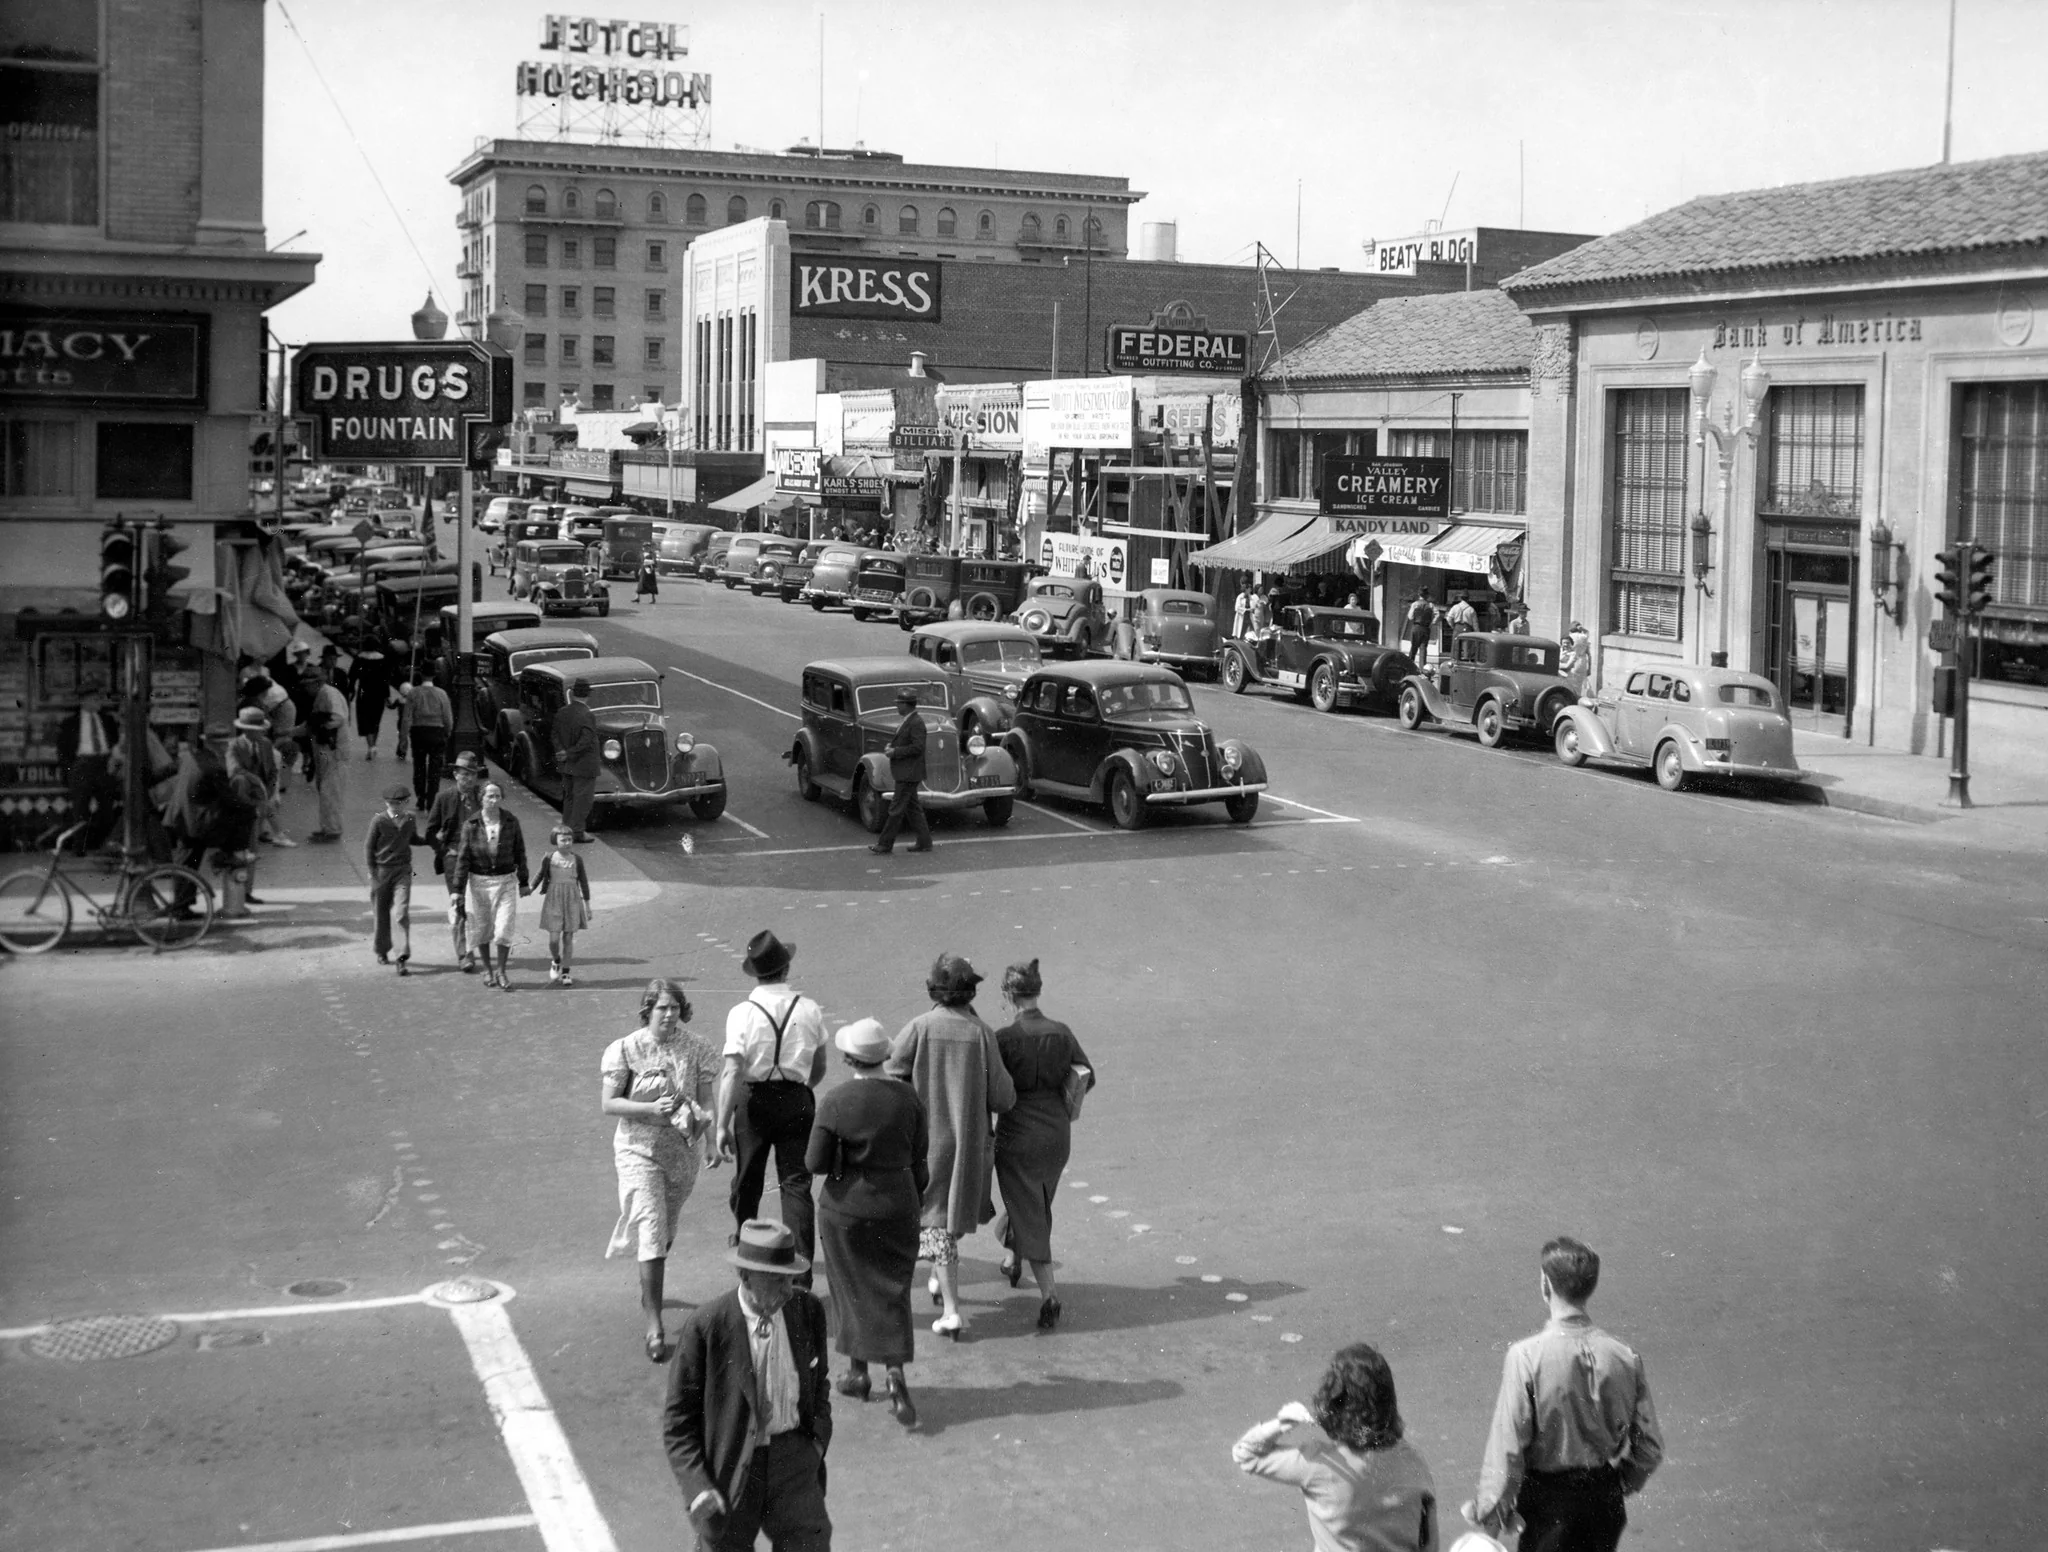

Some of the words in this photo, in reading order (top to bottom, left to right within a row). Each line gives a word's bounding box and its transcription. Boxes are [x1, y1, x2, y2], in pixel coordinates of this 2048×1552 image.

[543, 14, 688, 58] HOTEL
[519, 61, 711, 105] HUGHSON
[1380, 243, 1423, 271] BEATY
[799, 266, 931, 313] KRESS
[1713, 318, 1767, 350] Bank
[1783, 316, 1804, 346] of
[1817, 312, 1922, 345] America
[1120, 332, 1242, 359] FEDERAL
[1142, 358, 1195, 368] OUTFITTING
[313, 363, 468, 400] DRUGS
[331, 417, 455, 440] FOUNTAIN
[896, 435, 954, 447] BILLIARD
[1366, 467, 1408, 476] VALLEY
[823, 478, 855, 488] KARL'S
[1337, 475, 1440, 494] CREAMERY
[1357, 494, 1375, 504] ICE
[1381, 495, 1418, 505] CREAM
[1335, 520, 1388, 533] KANDY
[1392, 521, 1430, 534] LAND
[1058, 543, 1079, 555] FUTURE
[1096, 548, 1104, 557] OF
